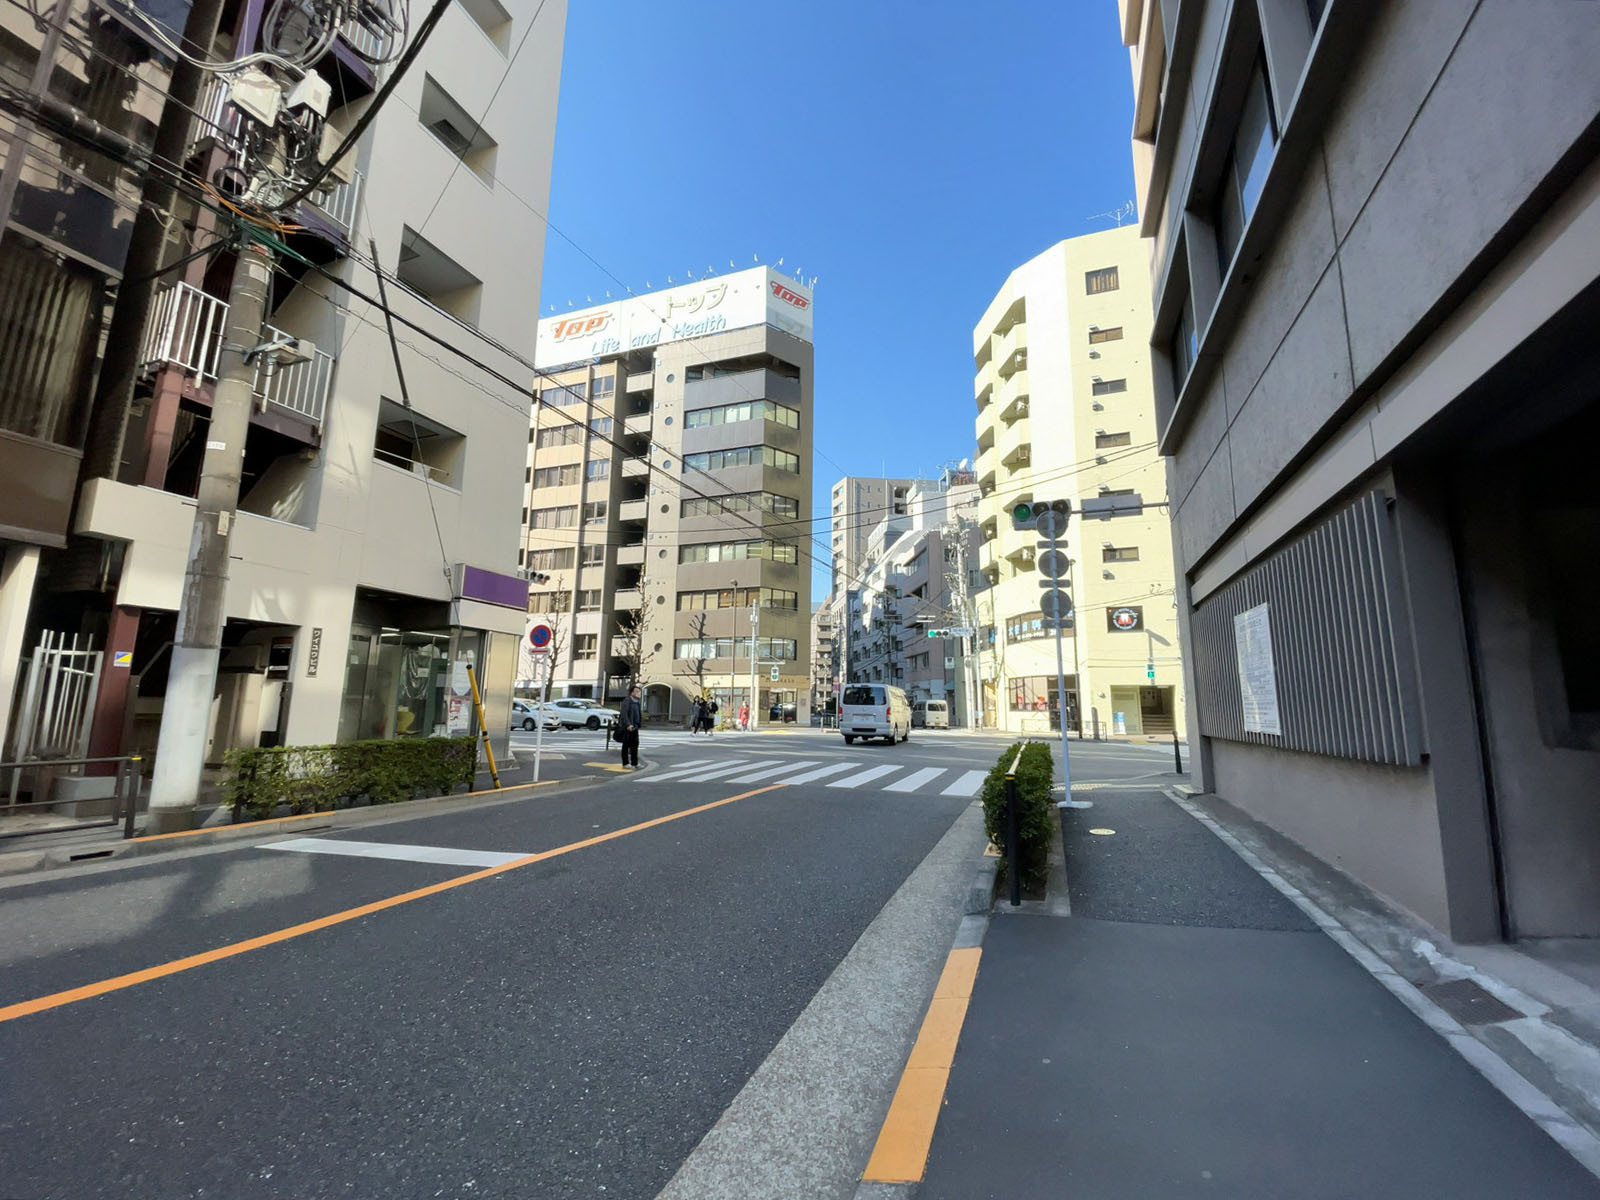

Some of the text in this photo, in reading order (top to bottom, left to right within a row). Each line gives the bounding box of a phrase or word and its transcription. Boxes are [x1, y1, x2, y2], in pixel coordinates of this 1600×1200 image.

[666, 284, 728, 319] トップ
[592, 315, 727, 356] Life and Health
